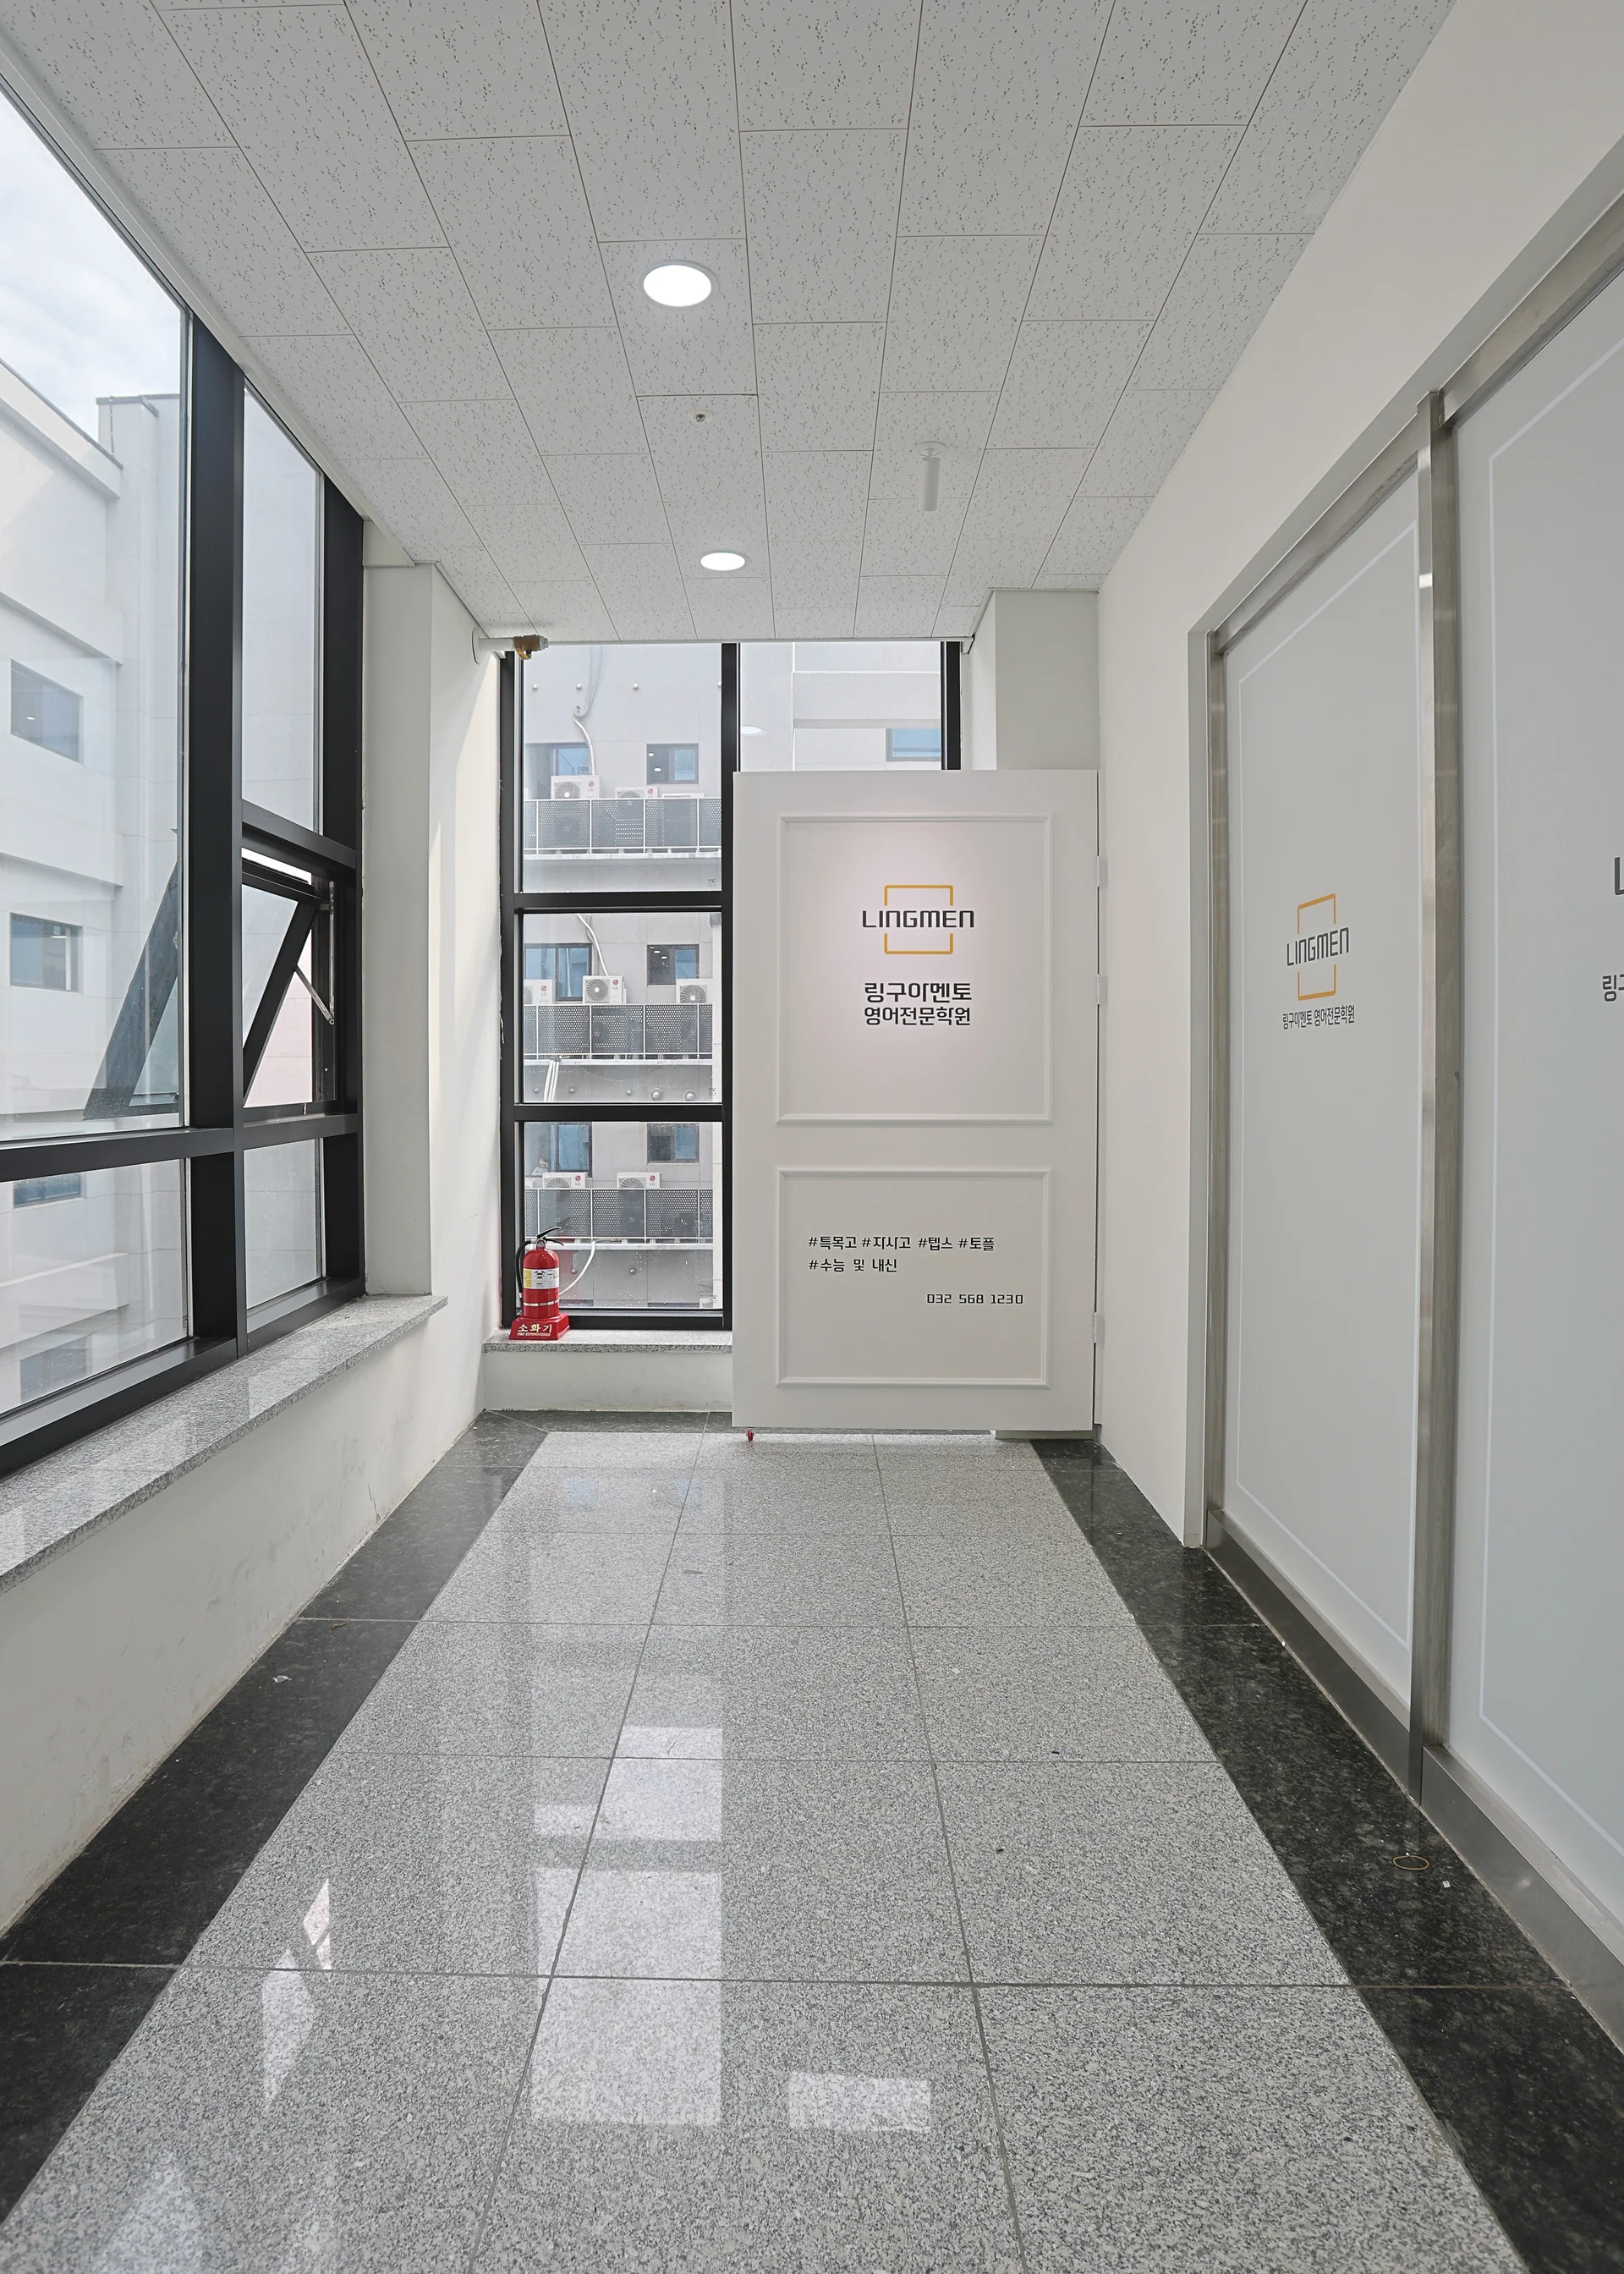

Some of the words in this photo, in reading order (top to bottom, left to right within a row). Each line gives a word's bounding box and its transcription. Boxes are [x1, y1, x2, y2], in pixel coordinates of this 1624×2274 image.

[863, 910, 974, 927] LINGMEN
[1287, 927, 1349, 966] LINGMEN
[864, 983, 972, 1002] 링구아멘토
[864, 1007, 970, 1025] 영어전문학원
[1283, 1011, 1312, 1030] 링구아멘토
[1314, 1005, 1354, 1026] 영어전문학원
[808, 1237, 857, 1250] #특목고
[861, 1237, 911, 1250] #자사고
[918, 1238, 952, 1250] #텝스
[958, 1238, 994, 1251] #토플
[809, 1259, 845, 1272] #수능
[853, 1259, 864, 1271] 및
[873, 1259, 897, 1272] 내신
[927, 1294, 952, 1303] 032
[959, 1294, 984, 1304] 568
[991, 1294, 1023, 1304] 1230
[517, 1323, 552, 1332] 소화기
